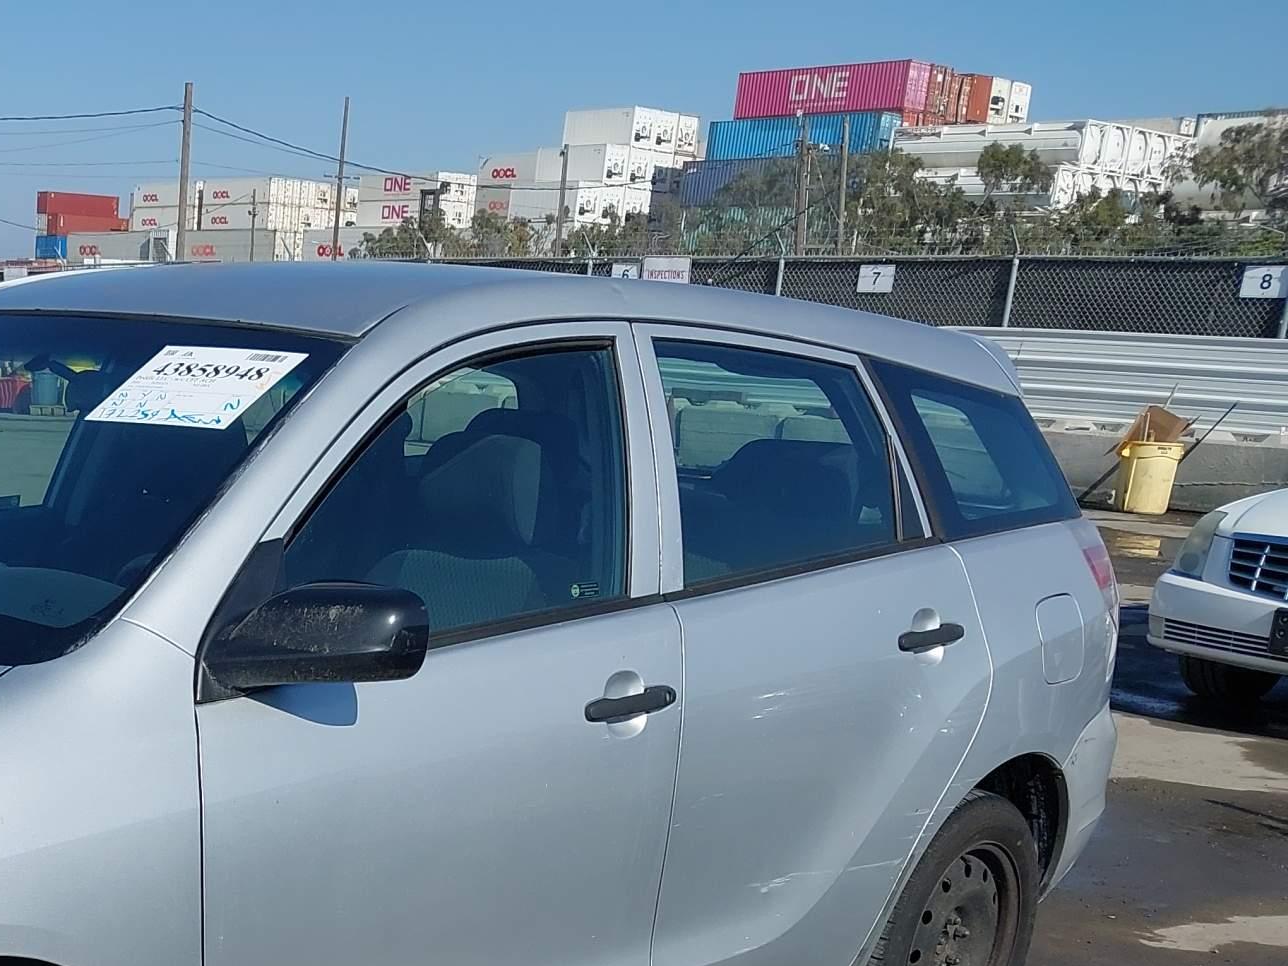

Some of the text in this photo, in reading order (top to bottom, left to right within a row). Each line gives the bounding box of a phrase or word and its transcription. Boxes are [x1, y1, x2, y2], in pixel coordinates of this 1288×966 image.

[789, 72, 849, 101] ONE
[491, 168, 517, 179] OOCL
[384, 177, 411, 192] ONE
[142, 194, 159, 202] OOCL
[213, 190, 230, 199] OOCL
[382, 205, 409, 219] ONE
[141, 218, 158, 227] OOCL
[211, 216, 228, 225] OOCL
[317, 245, 344, 257] OOL
[622, 269, 630, 279] 6
[647, 270, 685, 280] INSPECTIONS
[872, 271, 882, 286] 7
[1260, 274, 1272, 289] 8
[152, 361, 271, 382] 43858948
